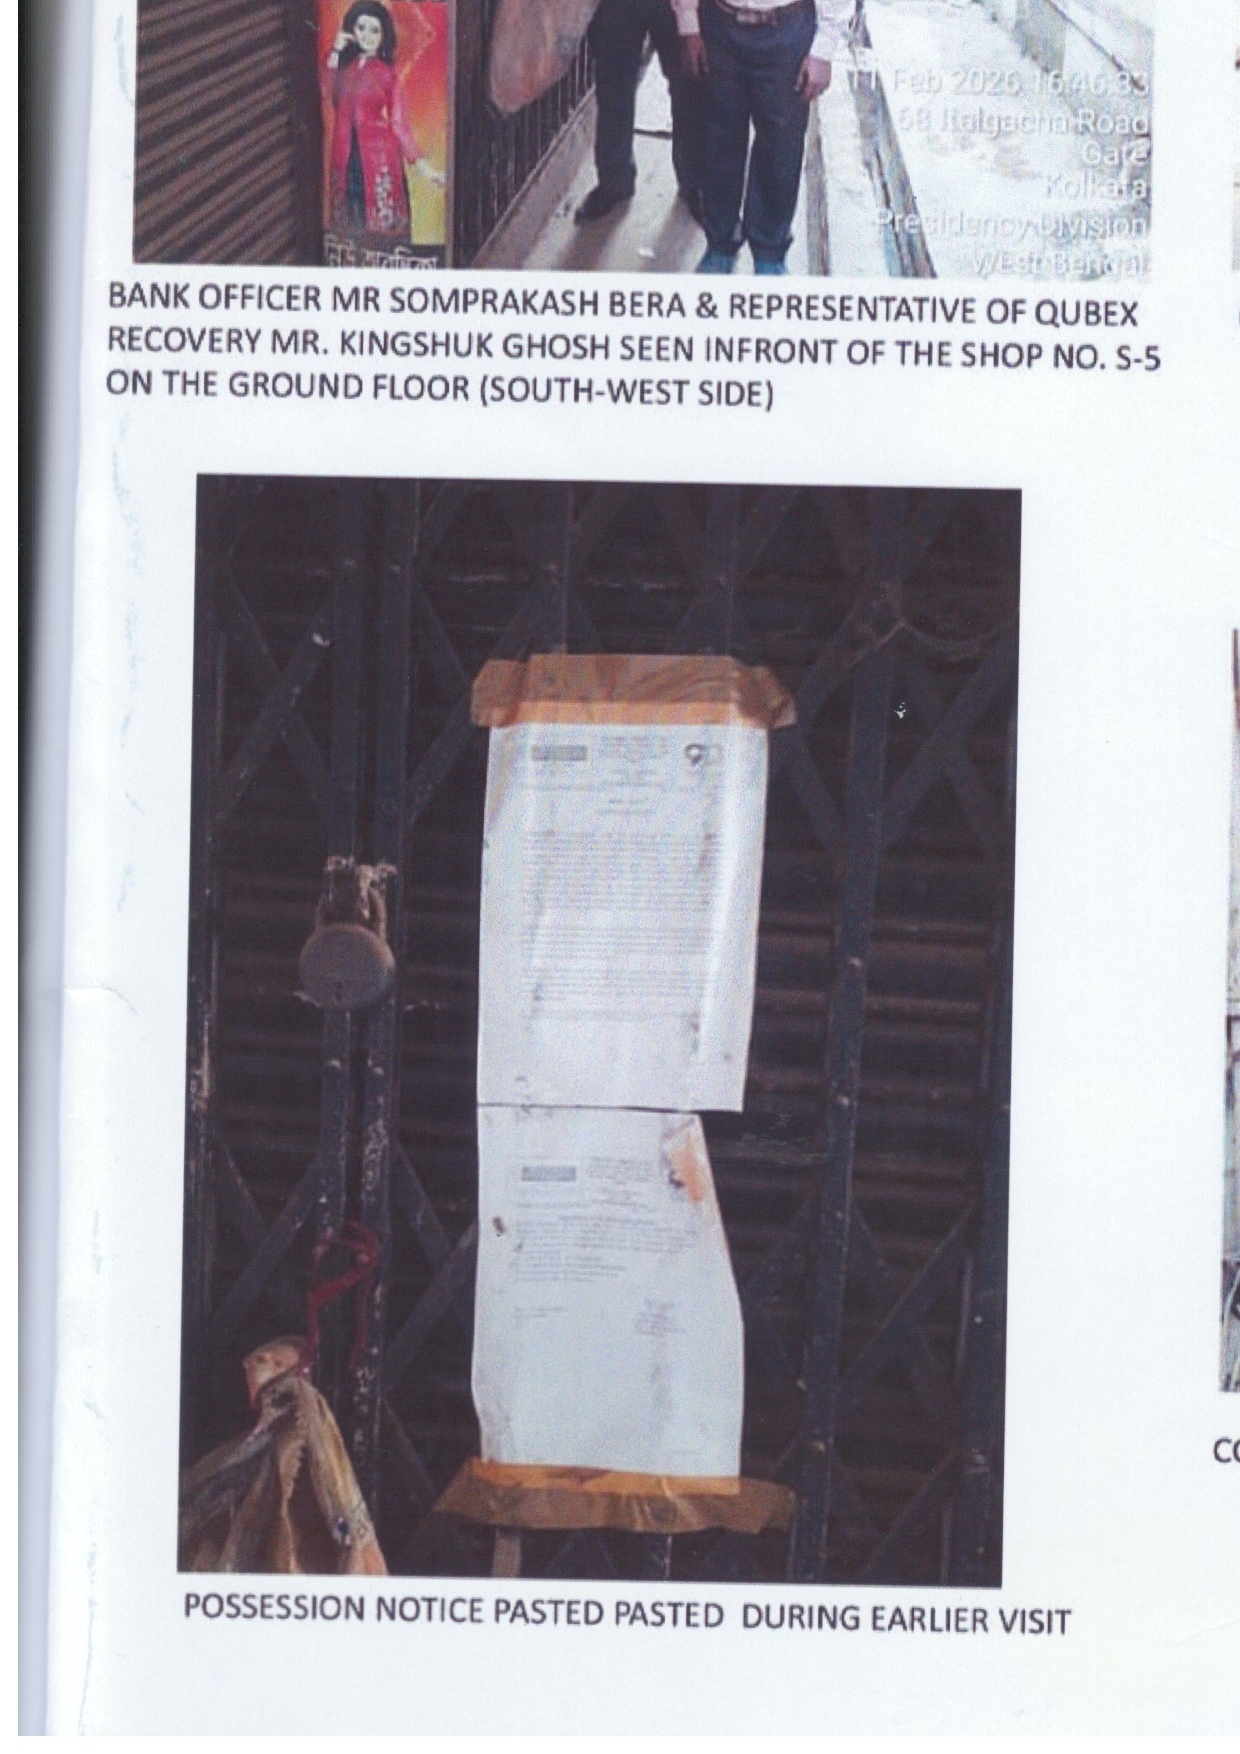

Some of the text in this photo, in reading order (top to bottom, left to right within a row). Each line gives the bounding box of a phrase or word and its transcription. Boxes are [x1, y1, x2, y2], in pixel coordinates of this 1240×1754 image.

[109, 282, 1138, 328] BANK OFFICER MR SOMPRAKASH BERA & REPRESENTATIVE OF QUBEX
[108, 326, 1161, 371] RECOVERY MR. KINGSHUK GHOSH SEEN INFRONT OF THE SHOP NO. S-5
[106, 369, 773, 412] ON THE GROUND FLOOR (SOUTH-WEST SIDE)
[185, 1593, 1072, 1634] POSSESSION NOTICE PASTED PASTED DURING EARLIER VISIT
